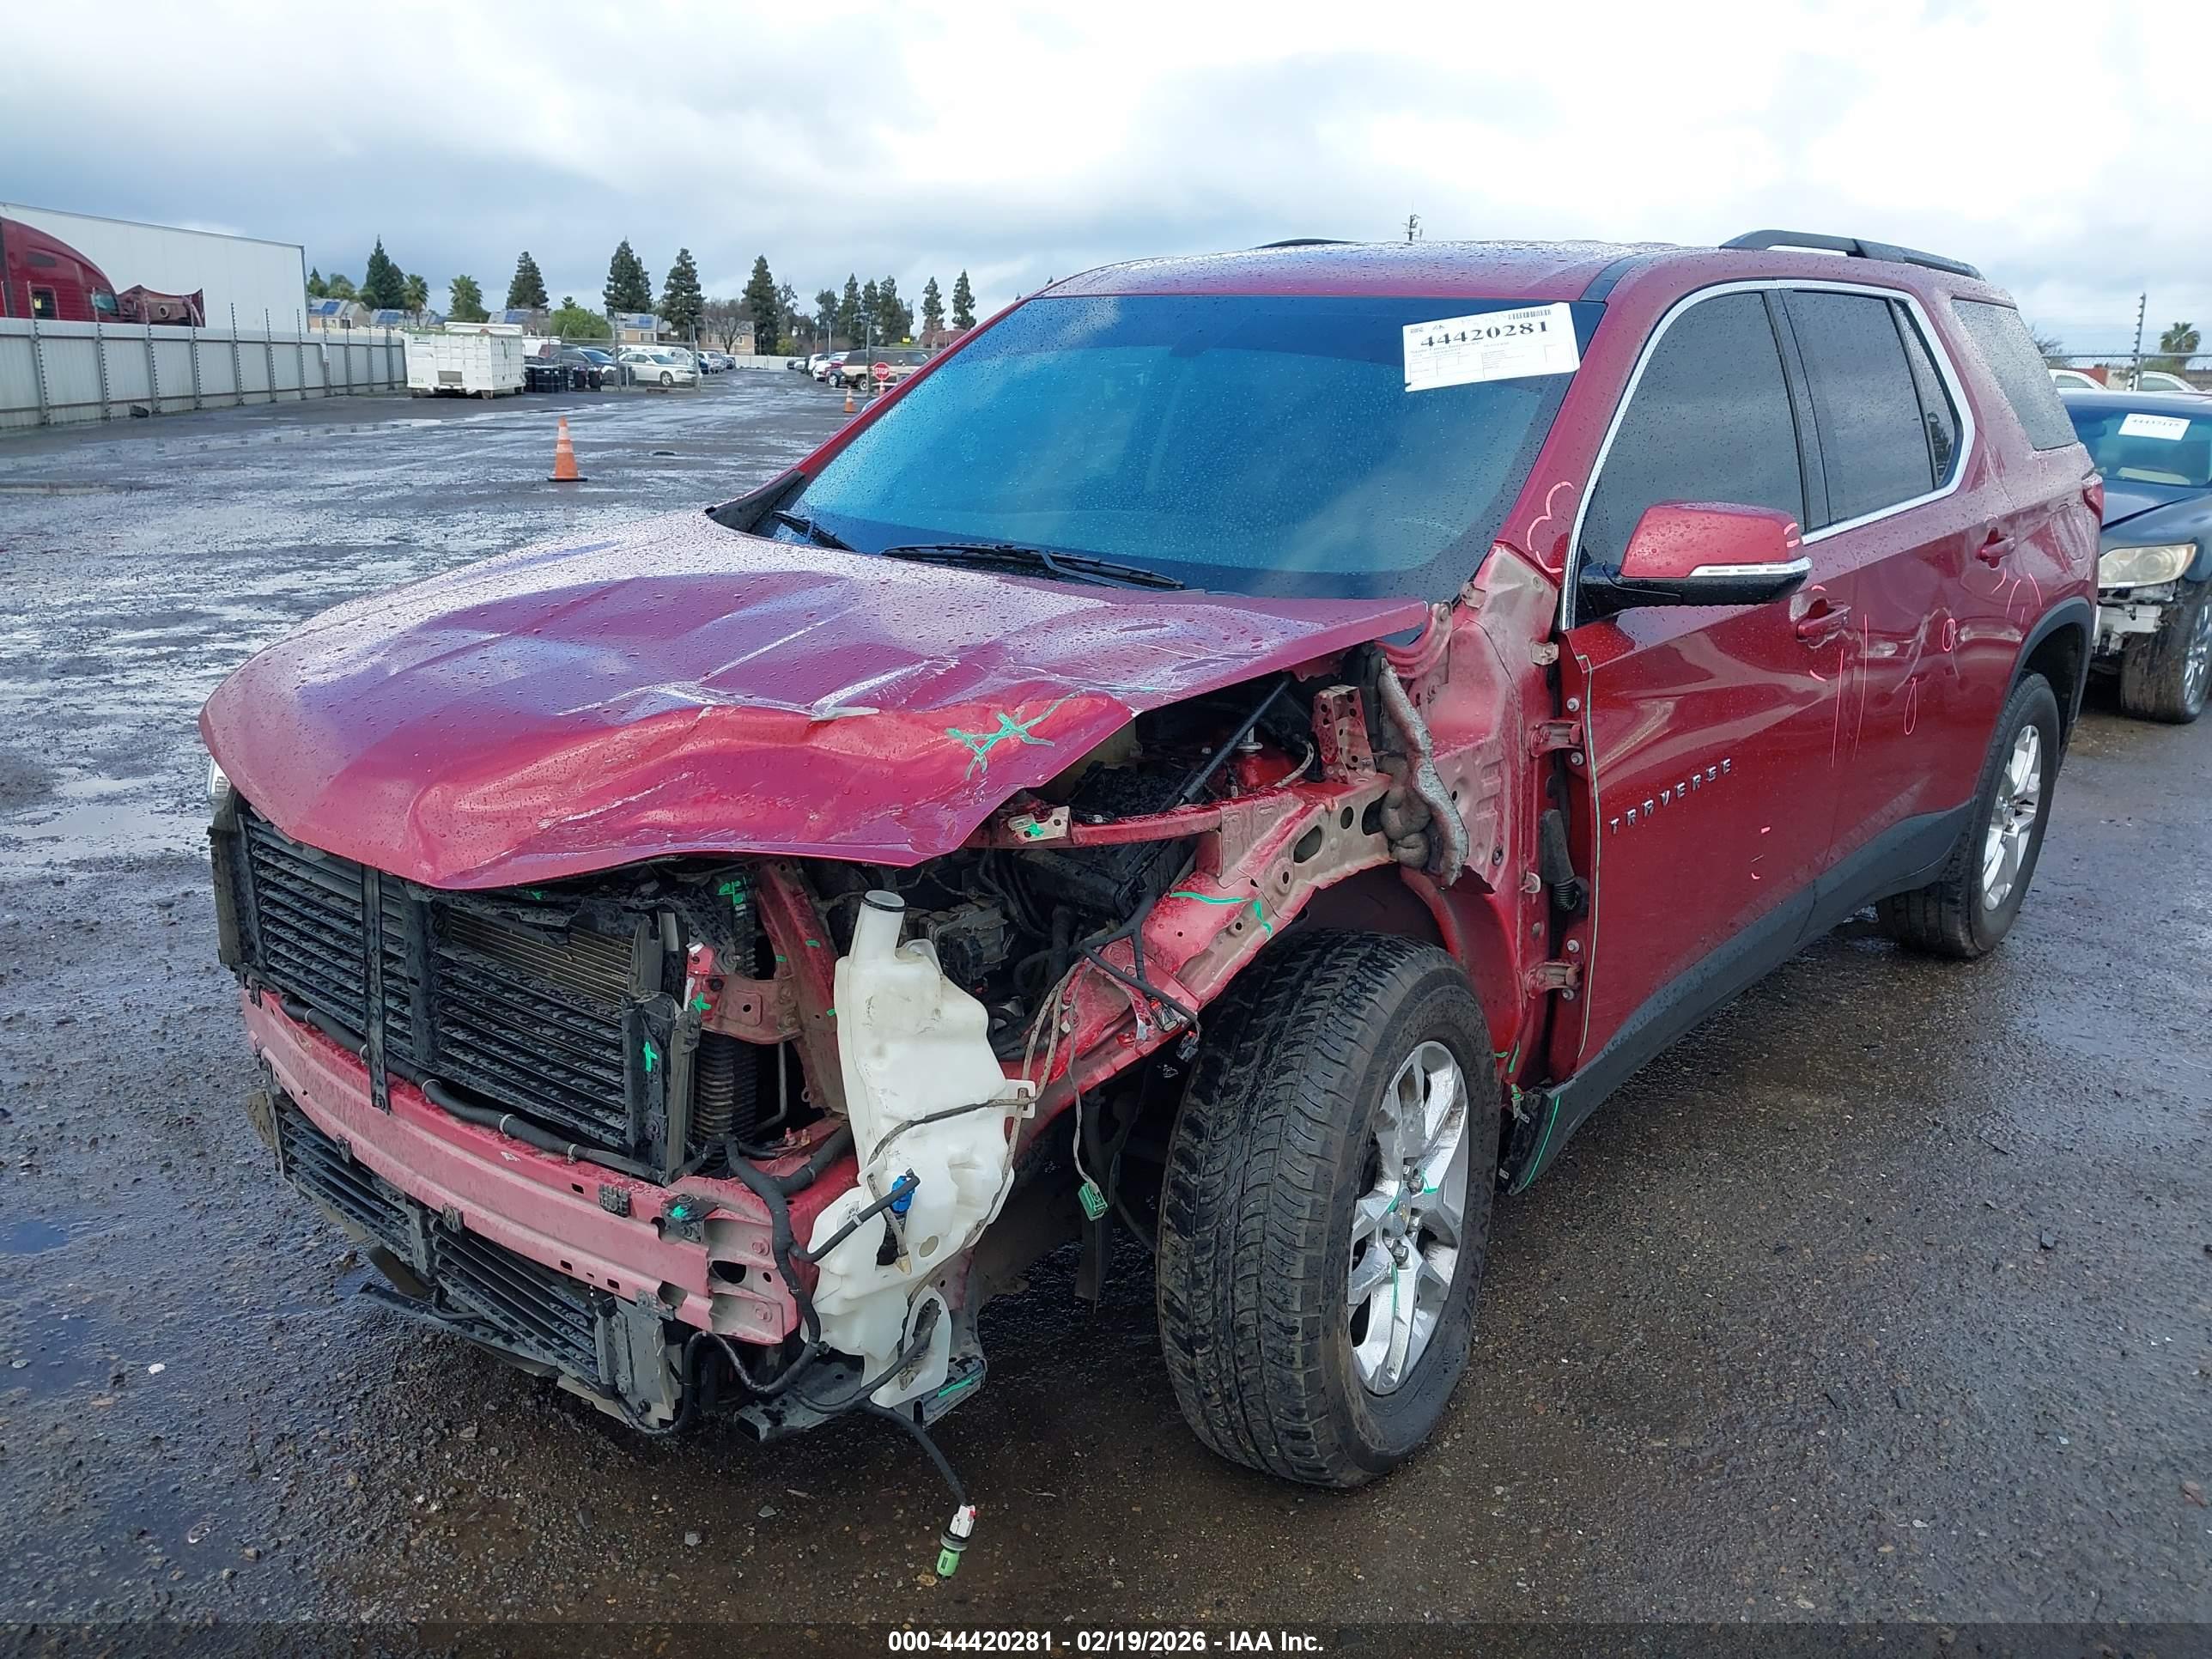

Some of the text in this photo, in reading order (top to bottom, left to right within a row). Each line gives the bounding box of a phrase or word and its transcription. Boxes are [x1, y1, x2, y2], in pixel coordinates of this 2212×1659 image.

[1420, 321, 1548, 347] 44420281
[875, 367, 889, 375] STOP
[1610, 758, 1731, 835] TRAVERSE
